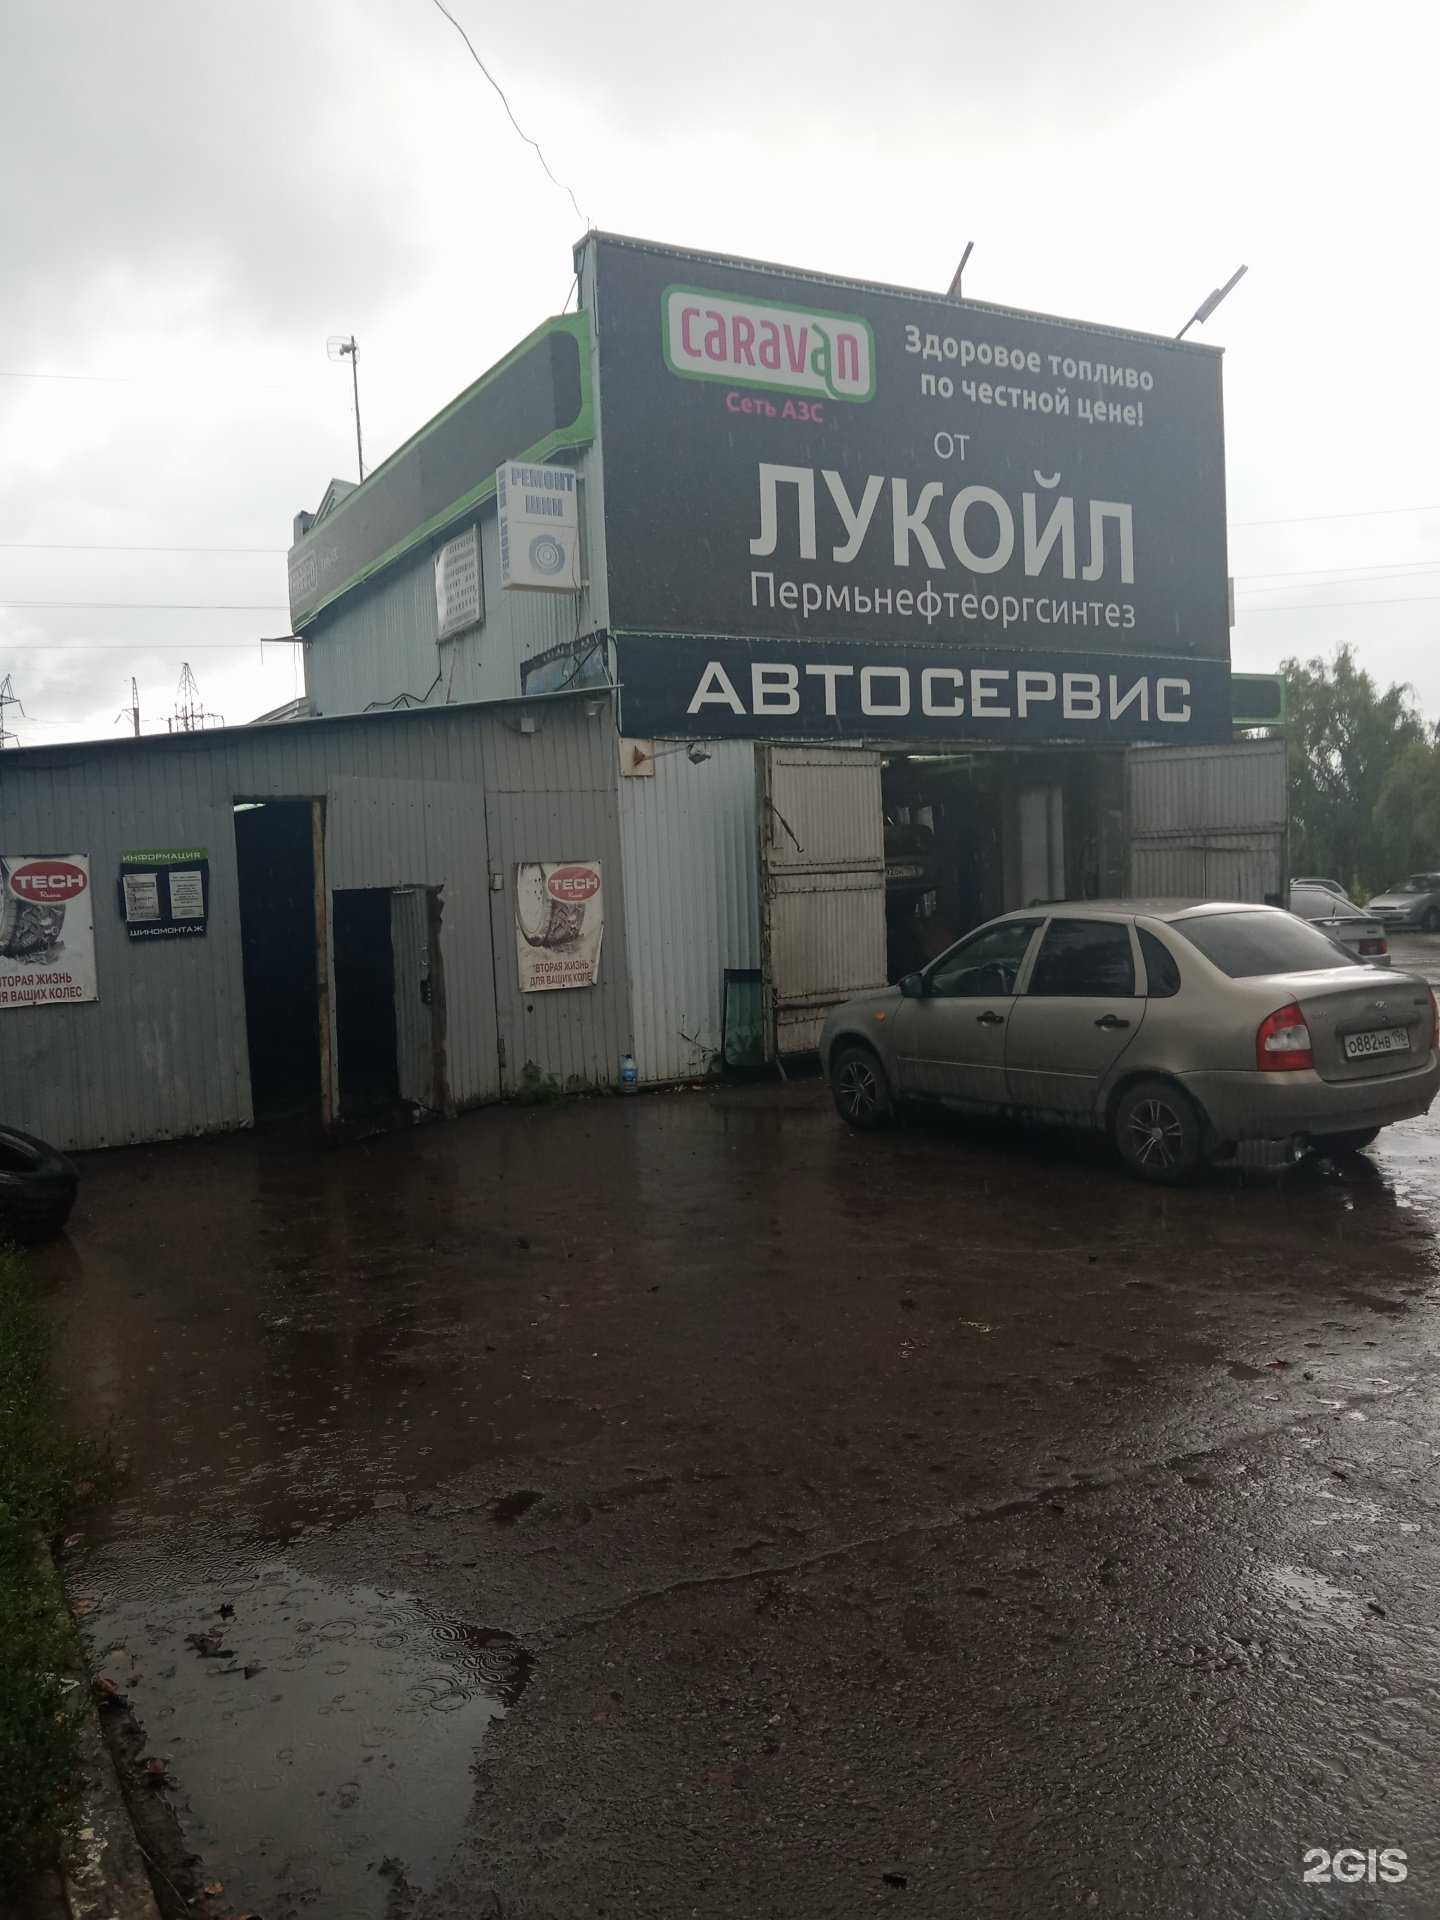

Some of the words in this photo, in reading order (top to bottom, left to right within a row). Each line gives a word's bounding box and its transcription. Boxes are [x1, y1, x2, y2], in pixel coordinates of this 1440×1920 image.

[904, 324, 1042, 373] Здоровое
[1047, 353, 1155, 392] топливо
[726, 391, 776, 417] Сеть
[781, 402, 824, 424] АЗС
[921, 373, 955, 399] по
[961, 379, 1070, 417] честной
[1078, 398, 1144, 427] цене!
[511, 467, 575, 492] РЕМОНТ
[749, 462, 1135, 585] ЛУКОЙЛ
[750, 570, 1136, 629] Пермьнефтеоргсинтез
[685, 660, 1192, 723] АВТОСЕРВИС
[122, 852, 201, 862] ИНФОРМАЦИЯ
[15, 874, 84, 889] TECH
[551, 877, 598, 890] TECH
[129, 925, 204, 937] ШИНОМОНТАЖ
[36, 972, 73, 985] ЖИЗНЬ
[10, 988, 48, 1002] ВАШИХ
[49, 986, 82, 999] КОЛЕС
